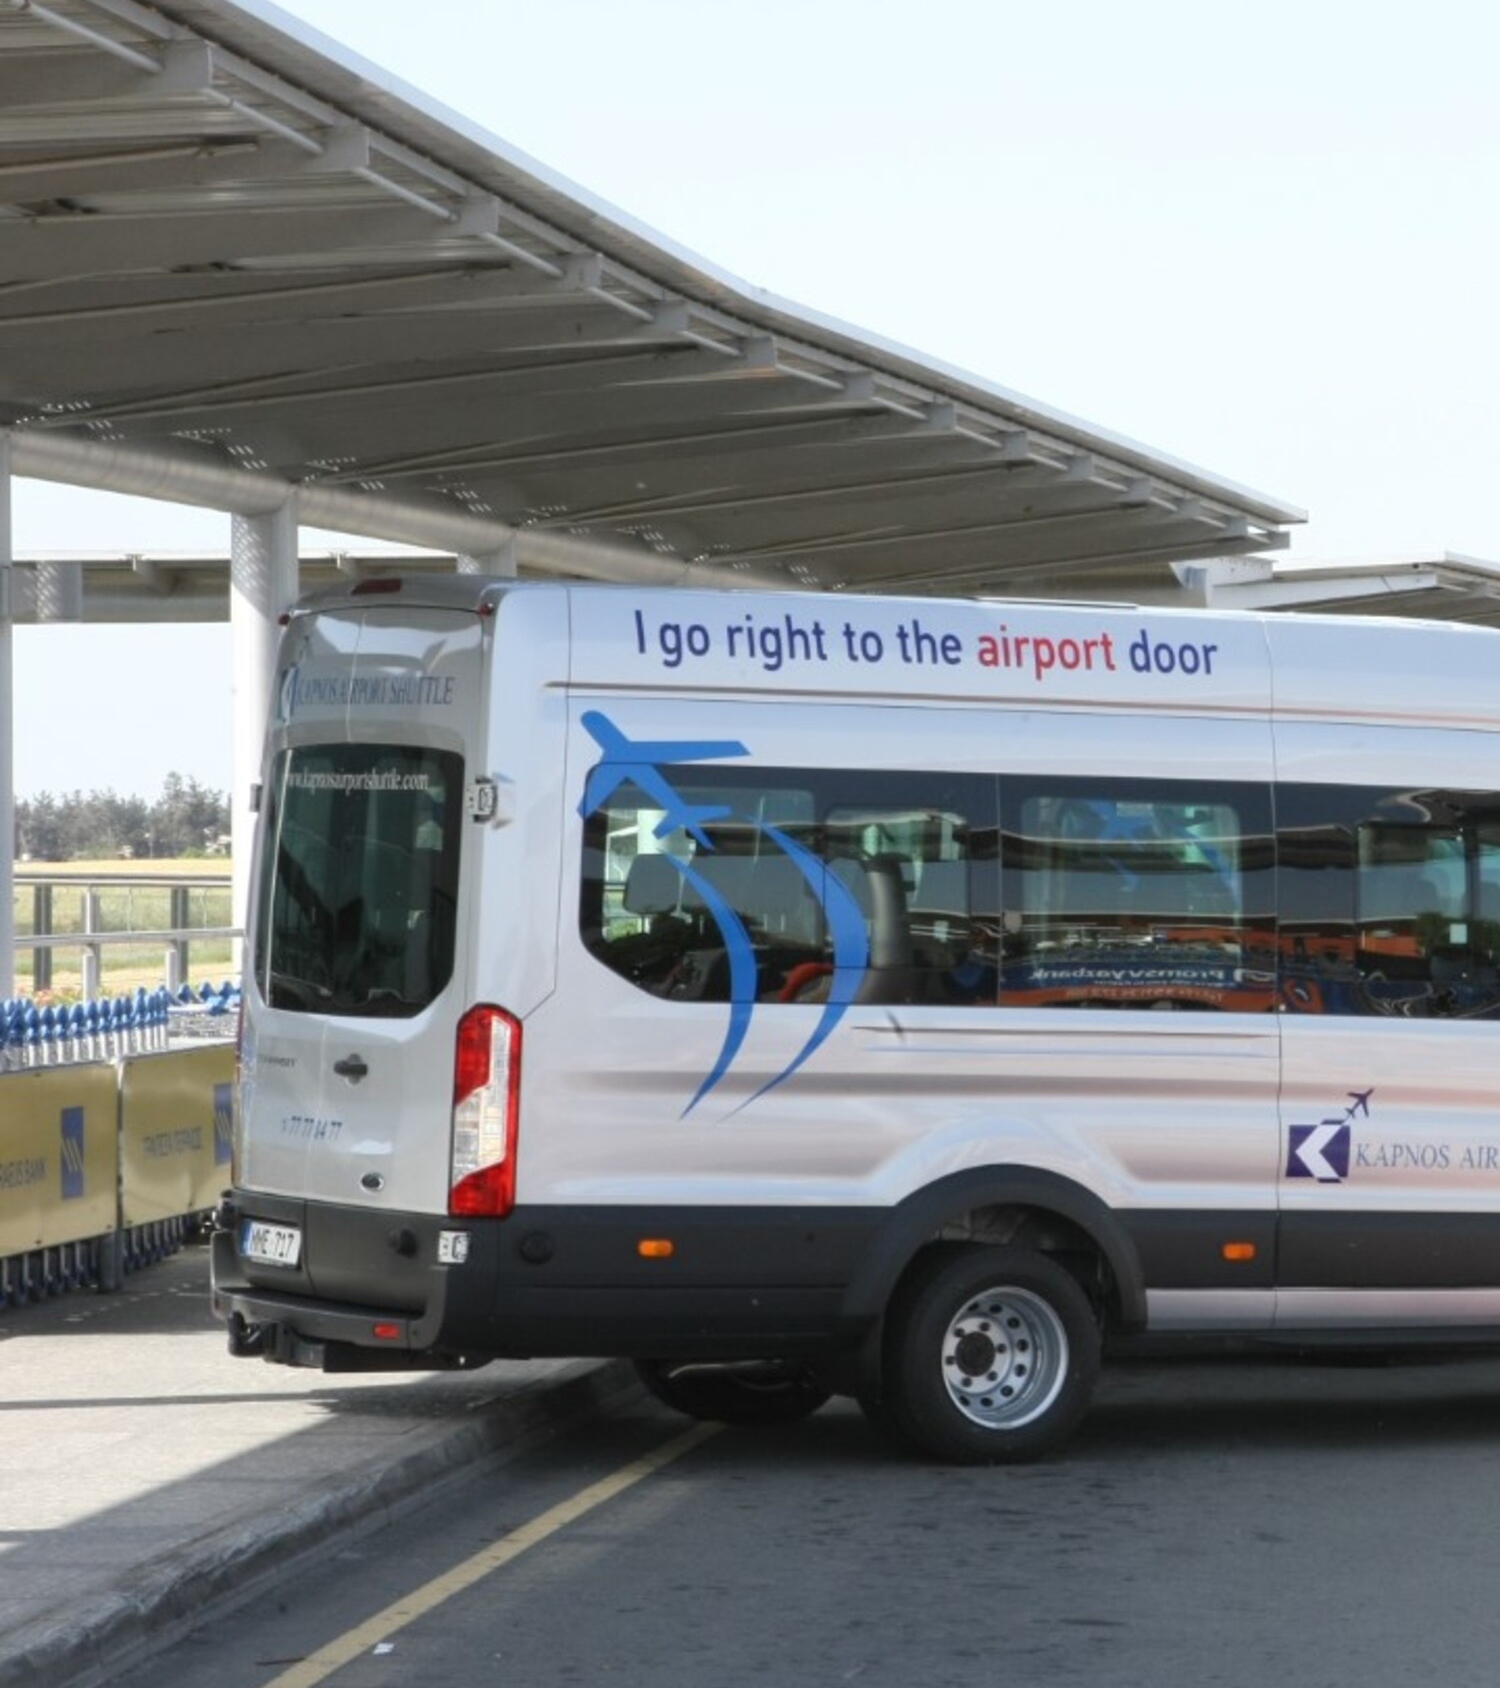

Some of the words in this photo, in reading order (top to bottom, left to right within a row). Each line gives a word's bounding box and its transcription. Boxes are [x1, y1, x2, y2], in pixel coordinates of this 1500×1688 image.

[634, 609, 647, 655] I
[659, 622, 711, 668] go
[726, 613, 825, 672] right
[843, 621, 884, 663] to
[898, 619, 963, 666] the
[977, 624, 1117, 680] airport
[1128, 629, 1220, 676] door
[389, 674, 456, 706] SHUTTLE
[1355, 1142, 1451, 1169] KAPNOS
